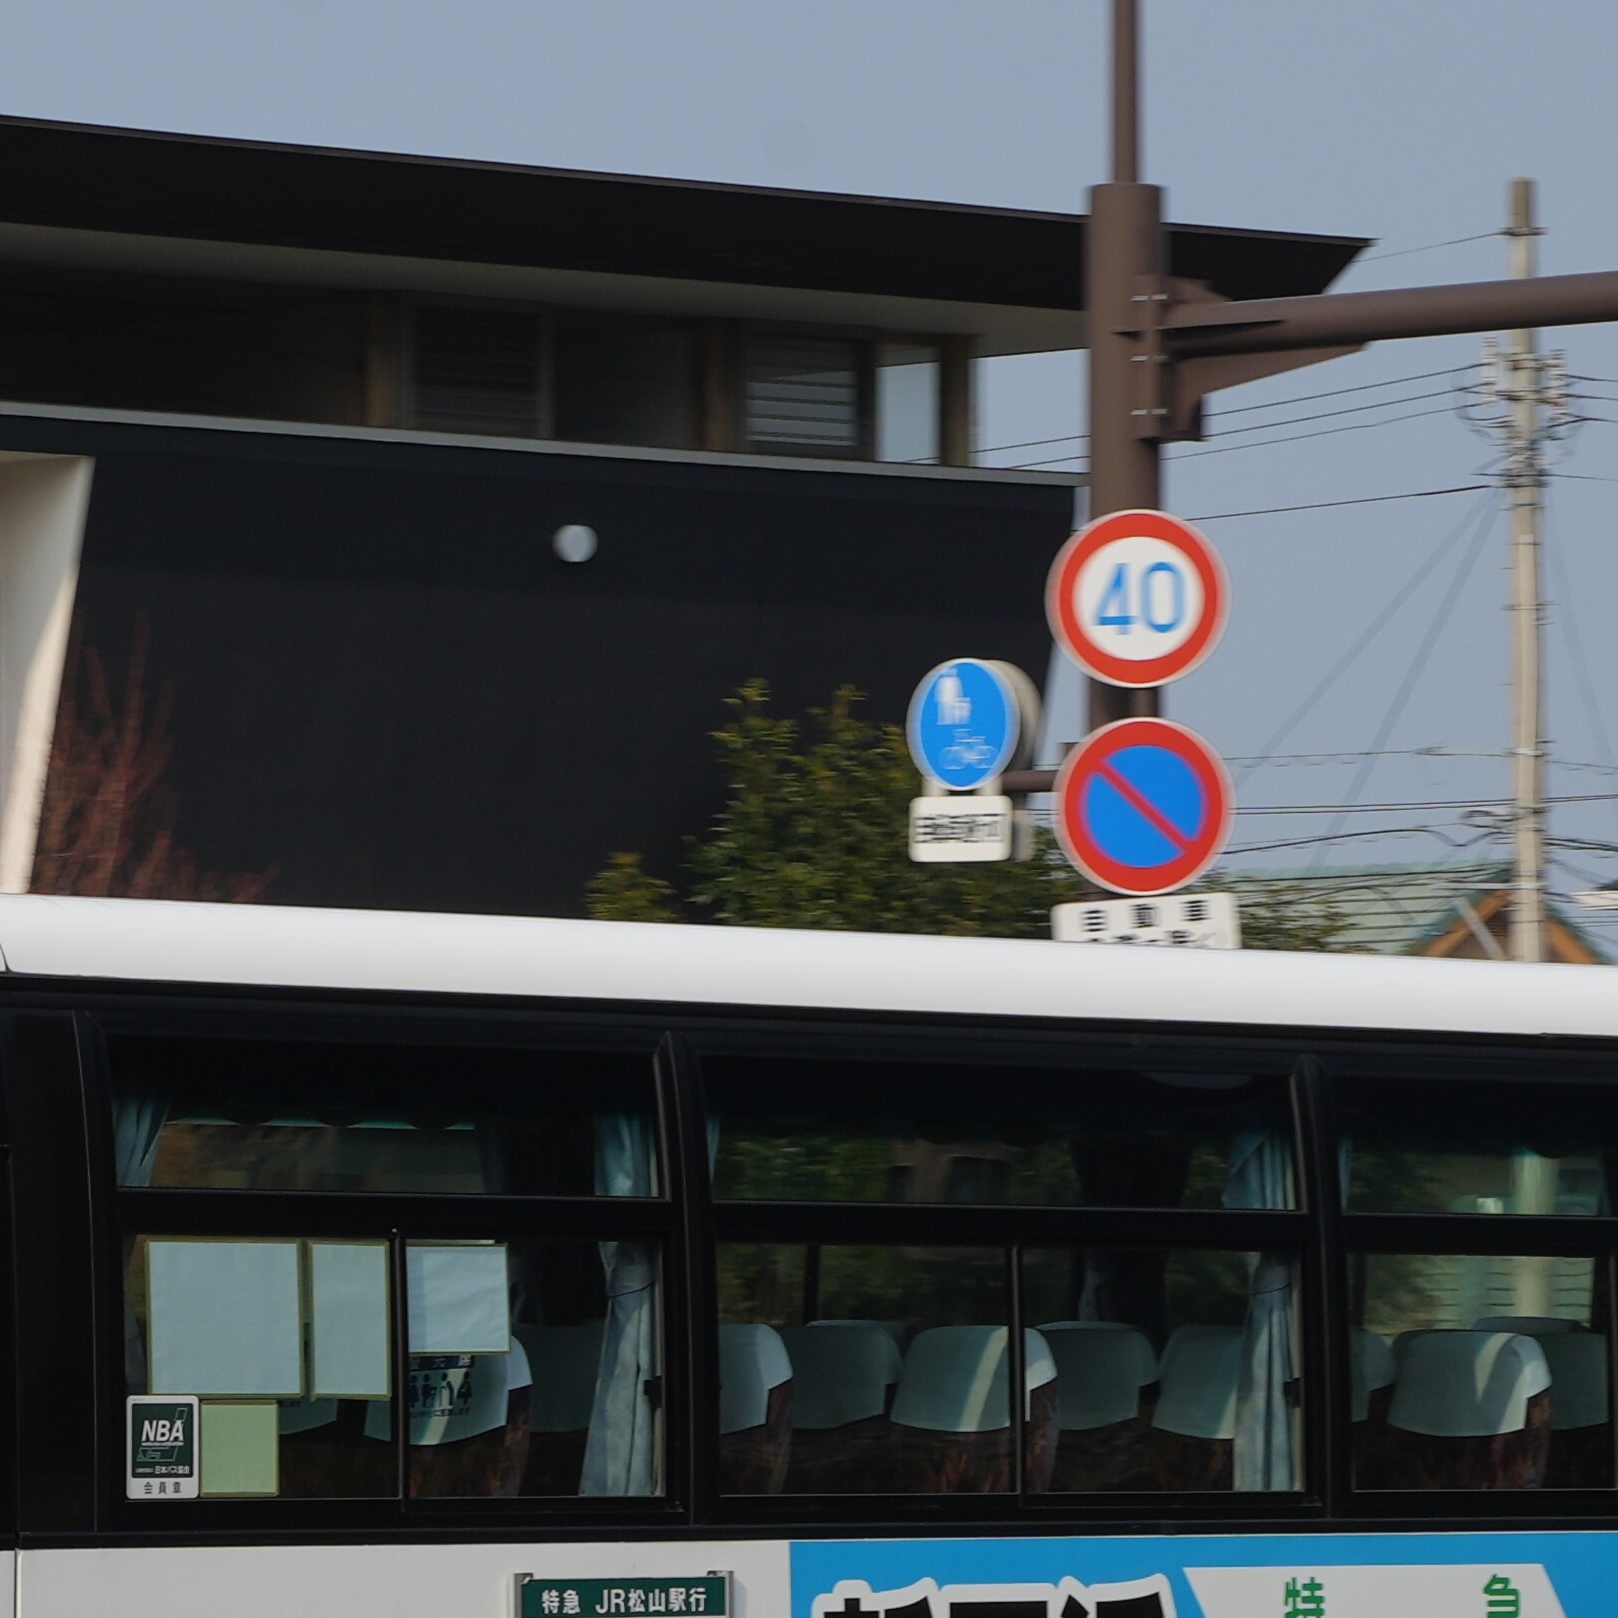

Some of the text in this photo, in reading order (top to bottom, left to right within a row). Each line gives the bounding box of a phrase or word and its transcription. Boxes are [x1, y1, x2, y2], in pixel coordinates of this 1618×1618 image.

[1093, 562, 1184, 635] 40
[141, 1420, 184, 1442] NBA
[541, 1587, 708, 1615] 特急 JR松山駅行
